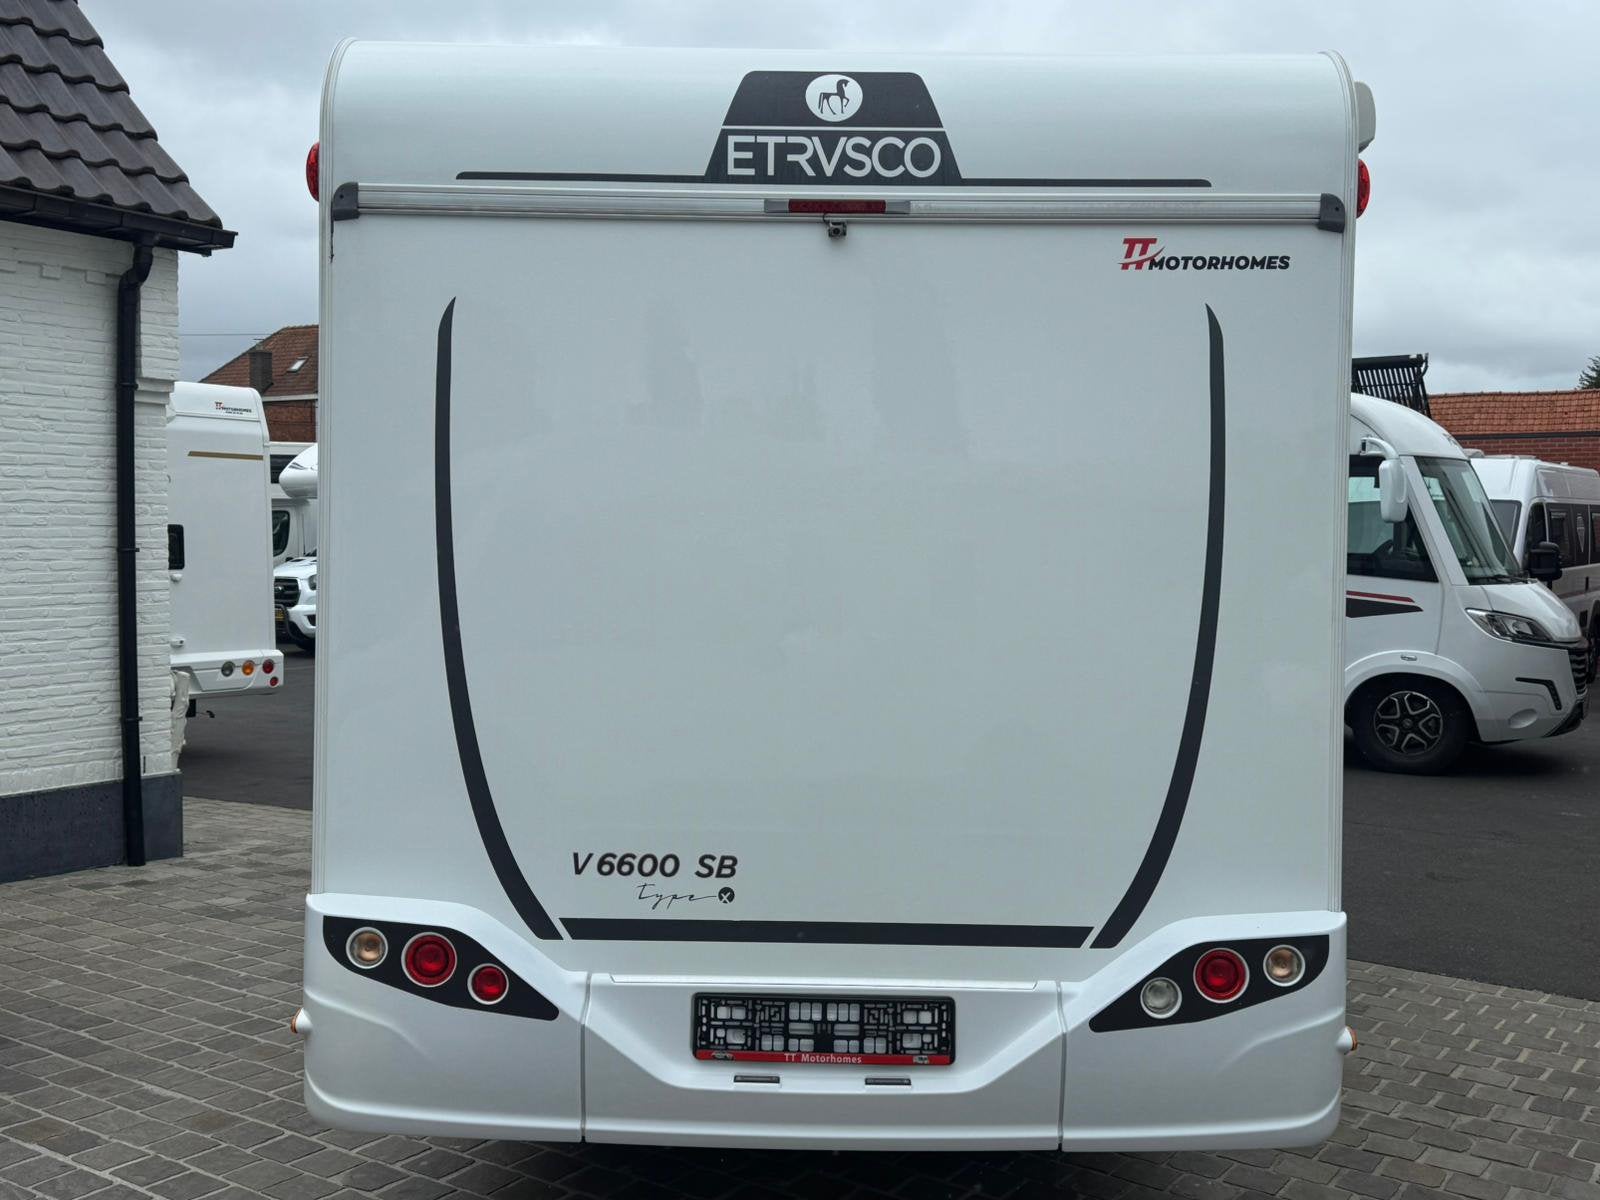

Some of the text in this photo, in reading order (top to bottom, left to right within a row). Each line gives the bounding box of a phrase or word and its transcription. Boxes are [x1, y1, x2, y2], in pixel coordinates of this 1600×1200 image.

[727, 135, 942, 178] ETRVSCO
[1148, 255, 1291, 271] MOTORHOMES
[573, 852, 738, 879] V 6600 SB
[784, 1053, 862, 1064] TT Motorhomes
